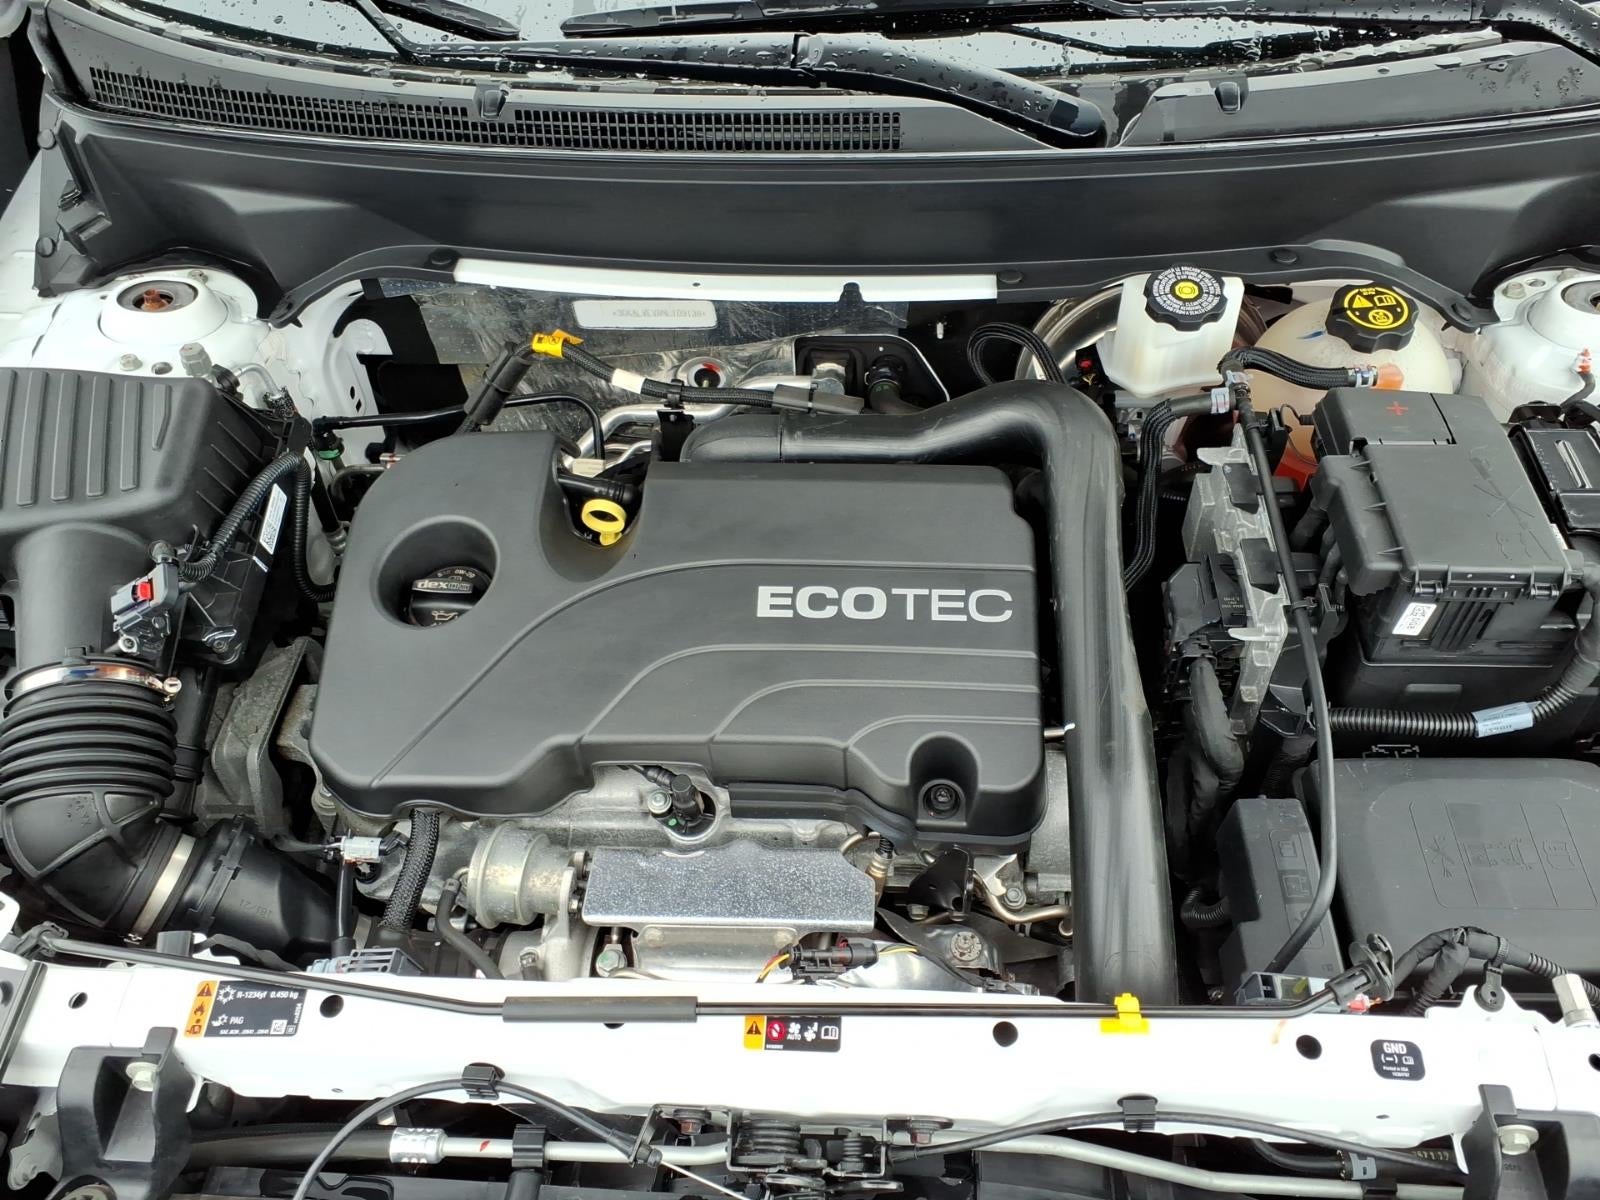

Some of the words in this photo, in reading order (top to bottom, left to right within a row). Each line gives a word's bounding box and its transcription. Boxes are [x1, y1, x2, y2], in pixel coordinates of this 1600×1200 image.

[417, 579, 470, 590] dexos
[756, 585, 1013, 623] ECOTEC
[236, 991, 267, 999] R-1234yf
[289, 990, 299, 1000] kg
[229, 1016, 244, 1025] PAG
[1382, 1041, 1407, 1054] GND
